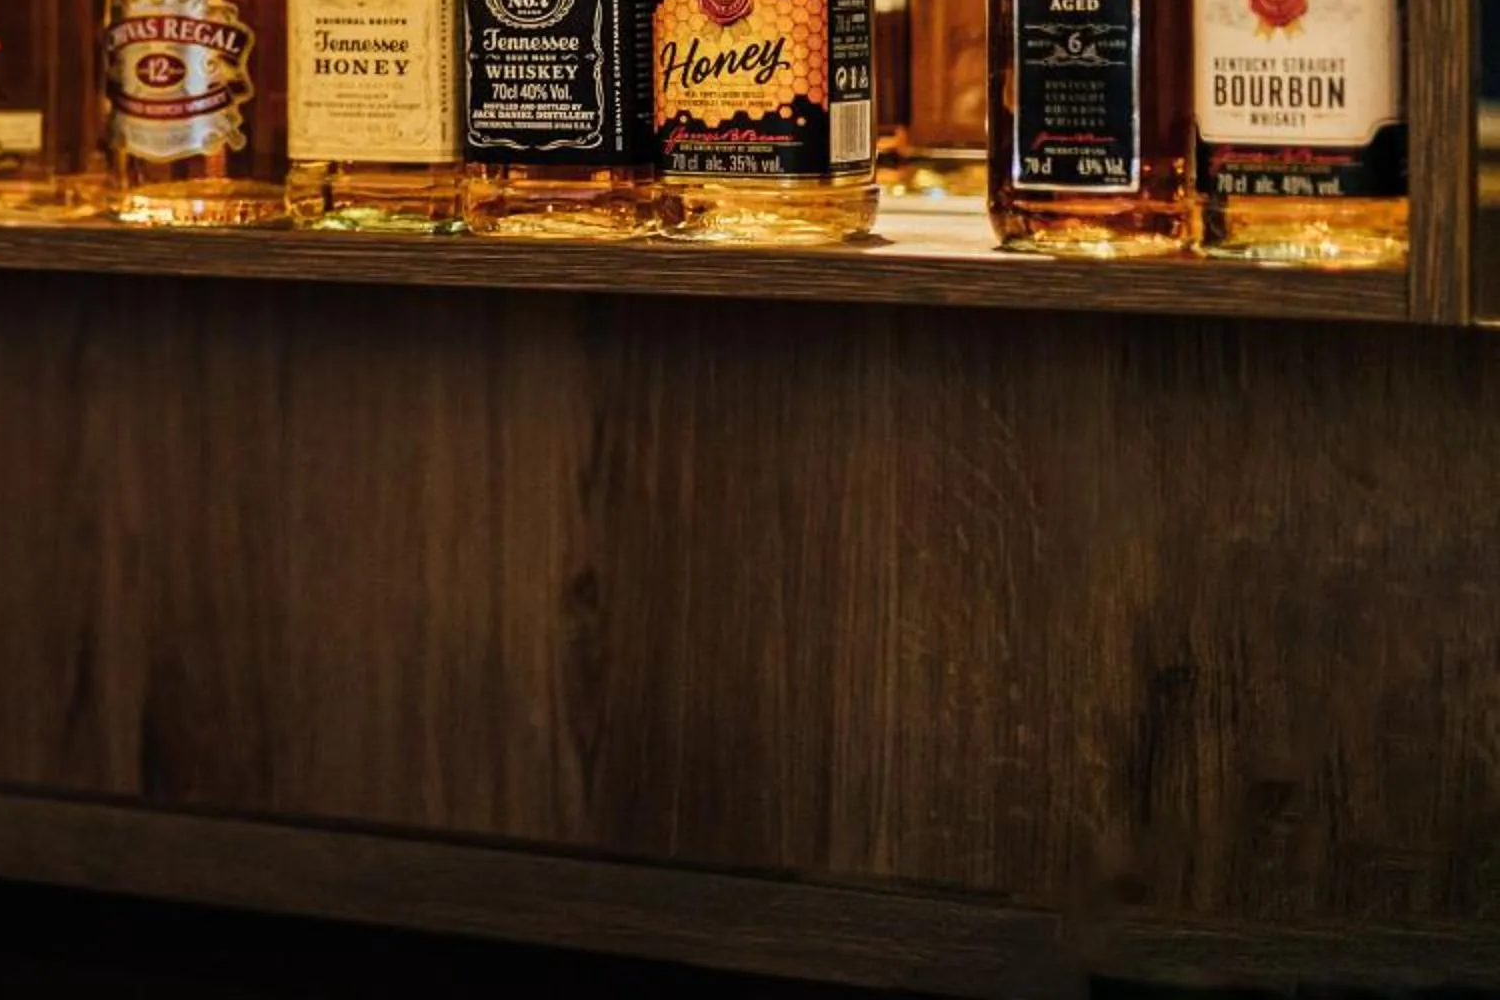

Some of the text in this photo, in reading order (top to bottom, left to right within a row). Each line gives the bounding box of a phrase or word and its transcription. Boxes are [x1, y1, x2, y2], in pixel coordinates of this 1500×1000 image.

[163, 17, 241, 53] REGAL
[314, 29, 410, 52] Tennessee
[483, 27, 580, 51] Tennessee
[1067, 31, 1082, 53] 6
[148, 57, 169, 82] 12
[313, 58, 410, 76] HONEY
[485, 64, 580, 80] WHISKEY
[659, 37, 791, 93] Honey
[1213, 56, 1347, 74] KENTUCKY STRAIGHT
[1213, 74, 1347, 109] BOURBON
[1250, 111, 1307, 128] WHISKEY
